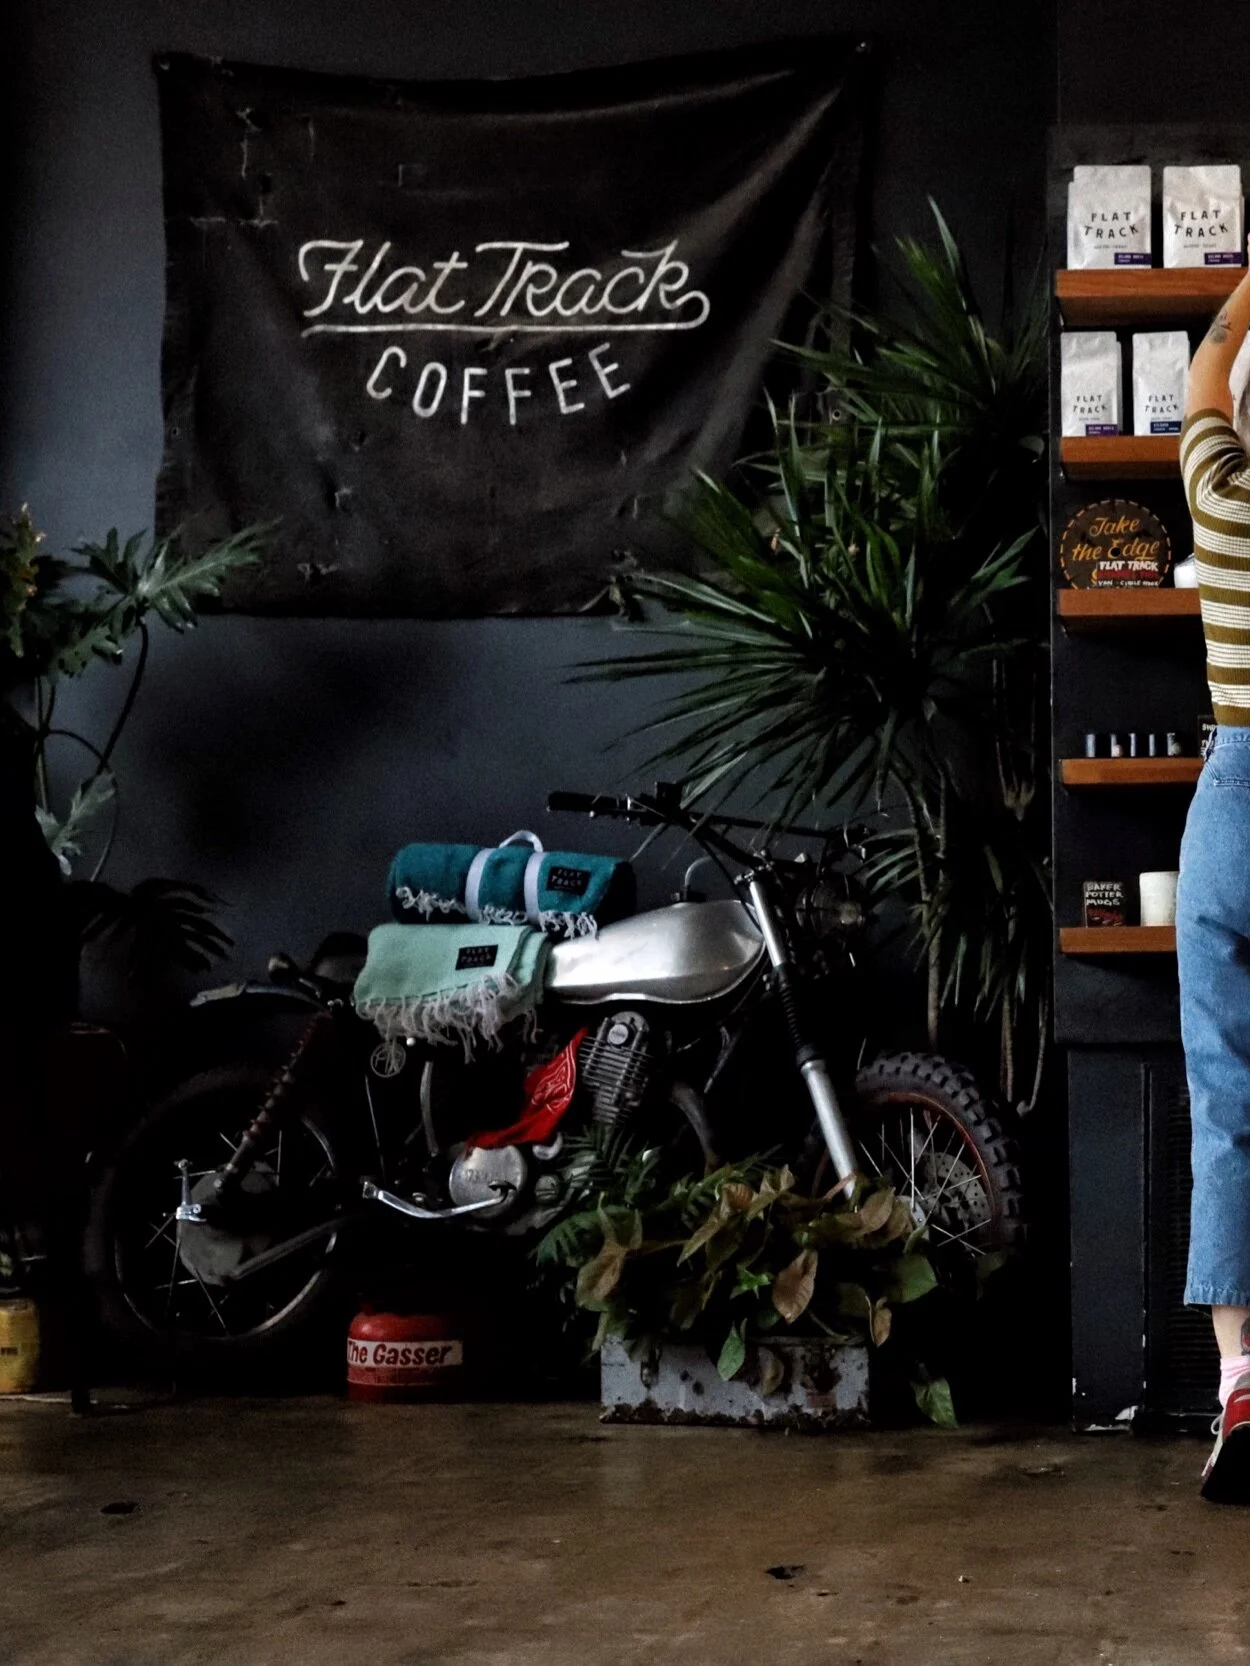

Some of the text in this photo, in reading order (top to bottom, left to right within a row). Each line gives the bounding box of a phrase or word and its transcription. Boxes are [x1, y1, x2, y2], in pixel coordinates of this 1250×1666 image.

[1092, 212, 1131, 222] FLAT
[1181, 210, 1221, 221] FLAT
[1084, 224, 1139, 239] TRACK
[1175, 223, 1229, 238] TRACK
[297, 238, 711, 330] Flat Track
[366, 341, 632, 426] COFFEE
[1090, 515, 1140, 537] Take
[1072, 543, 1102, 561] the
[348, 1341, 452, 1366] The Gasser
